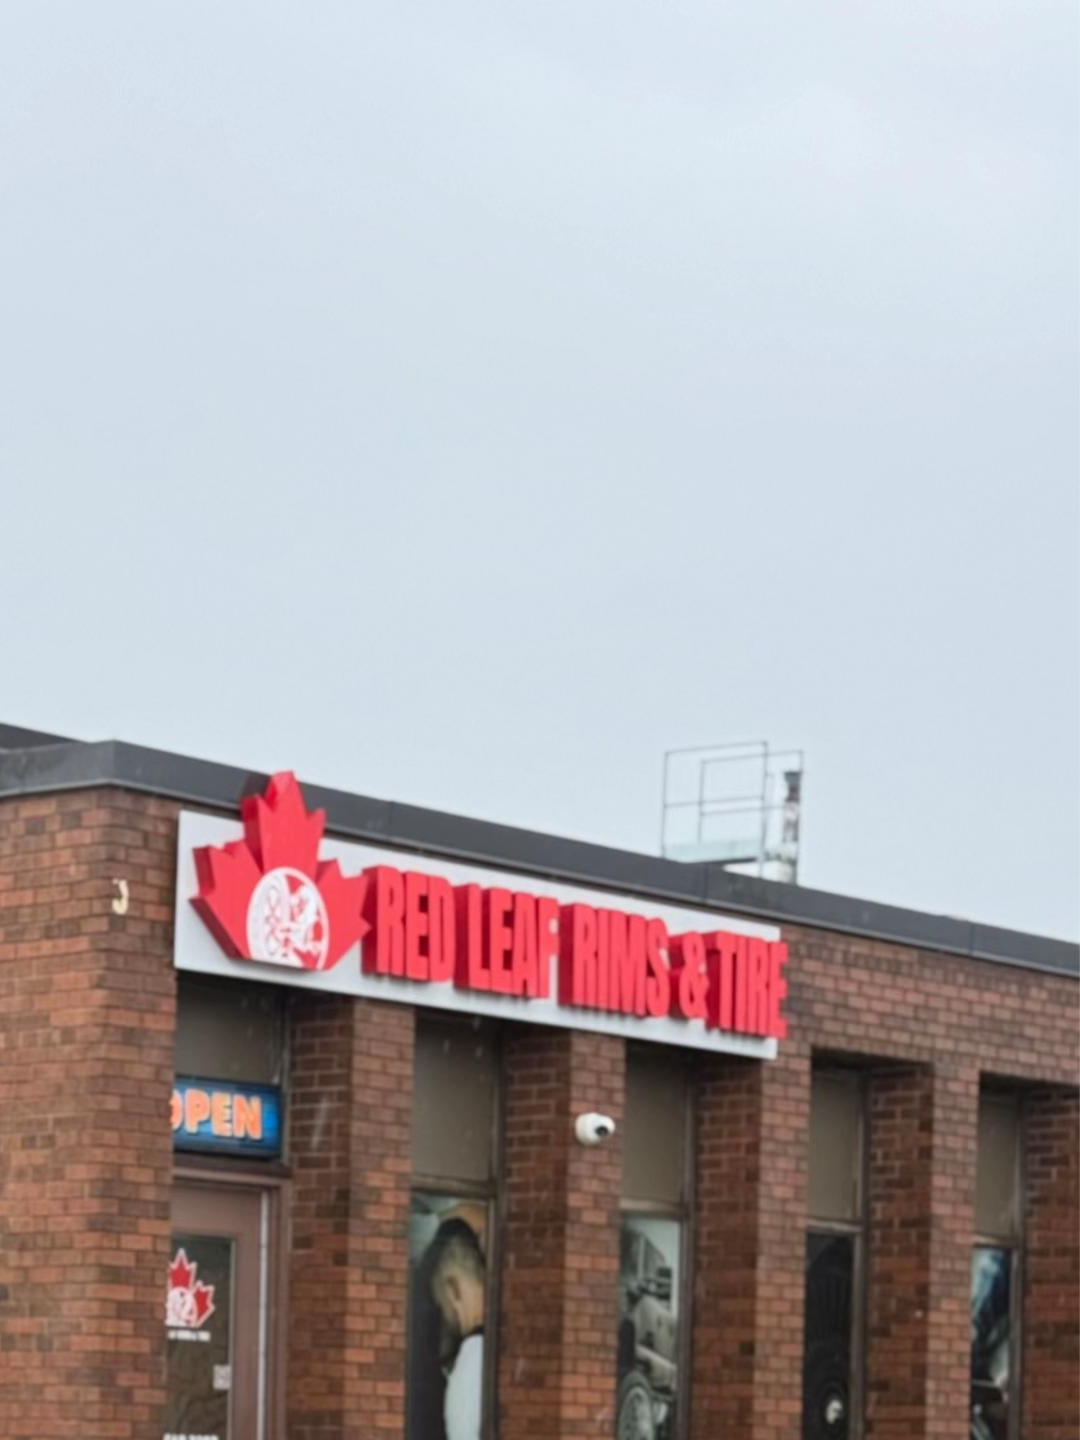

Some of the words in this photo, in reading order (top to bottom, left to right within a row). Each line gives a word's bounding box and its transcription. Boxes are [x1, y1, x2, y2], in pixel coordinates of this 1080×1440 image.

[373, 865, 456, 982] RED
[466, 883, 559, 998] LEAF
[570, 903, 670, 1018] RIMS
[677, 930, 710, 1019] &
[715, 930, 788, 1040] TIRE
